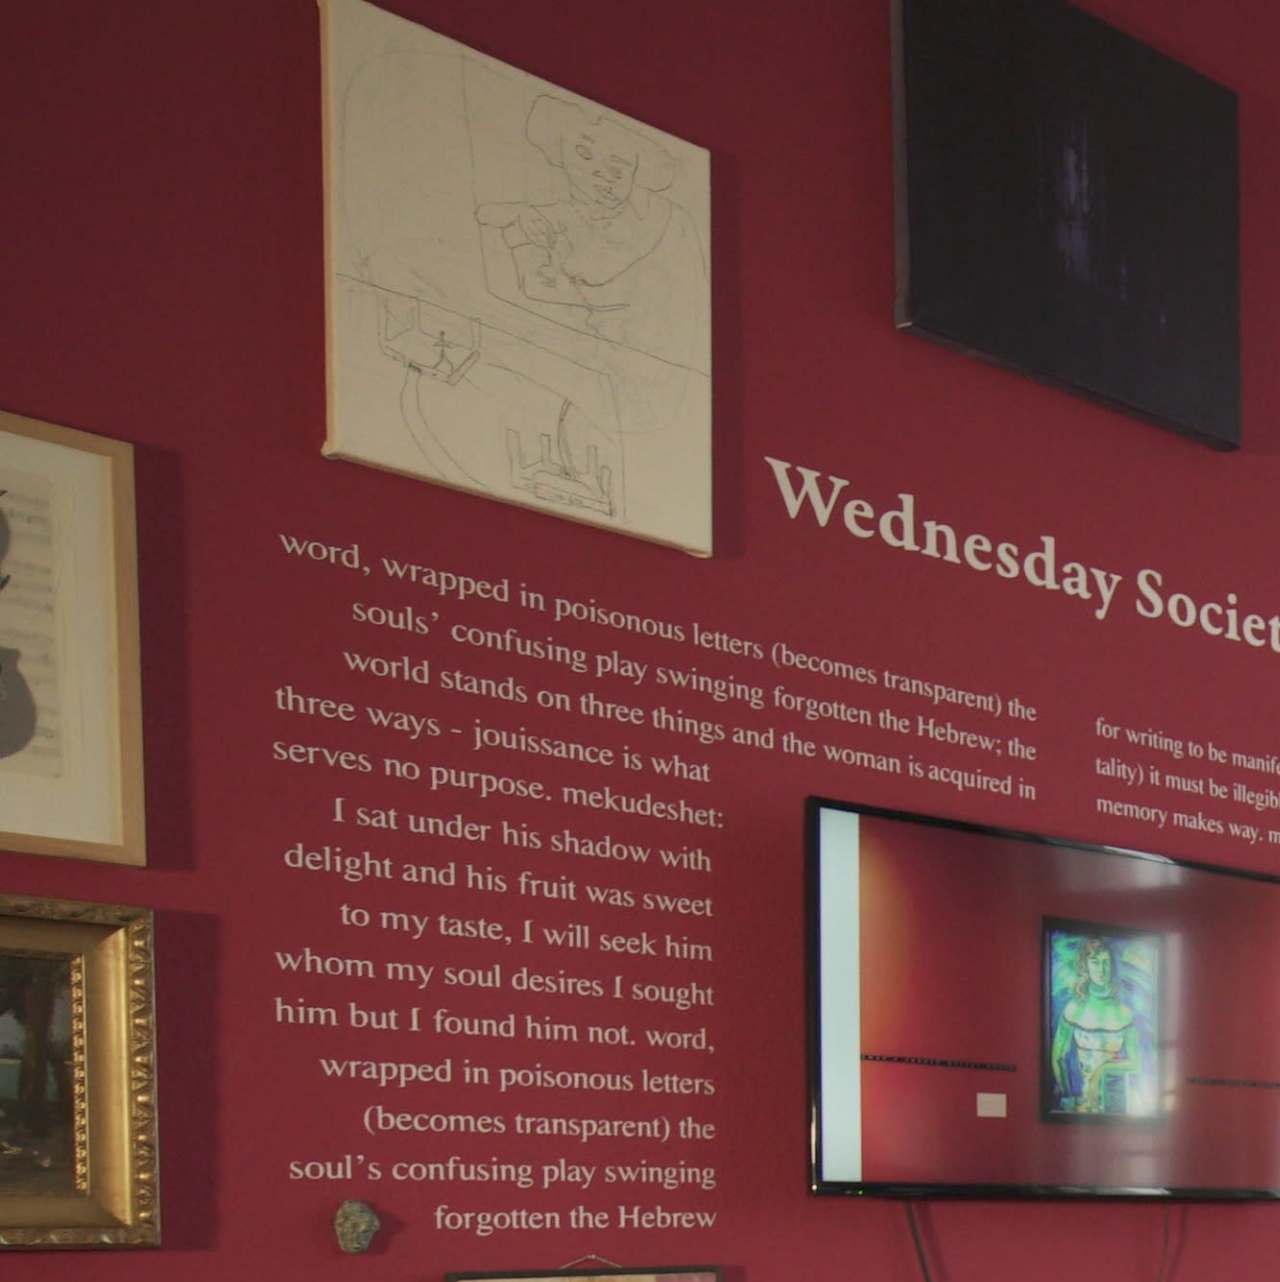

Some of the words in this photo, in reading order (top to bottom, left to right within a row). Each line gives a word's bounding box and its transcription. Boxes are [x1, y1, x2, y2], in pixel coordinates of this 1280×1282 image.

[763, 456, 1123, 621] Wednesday
[278, 534, 371, 576] word,
[380, 557, 509, 603] wrapped
[519, 582, 547, 612] in
[553, 598, 686, 642] poisonous
[692, 622, 764, 660] letters
[770, 642, 878, 685] (becomes
[882, 670, 1002, 718] transparent)
[1007, 697, 1037, 722] the
[342, 651, 429, 685] world
[440, 670, 528, 703] stands
[536, 690, 571, 712] on
[579, 692, 645, 725] three
[651, 706, 726, 744] things
[732, 727, 774, 750] and
[781, 731, 817, 757] the
[822, 744, 902, 774] woman
[907, 754, 925, 778] is
[927, 764, 1012, 796] acquired
[1018, 777, 1036, 800] in
[450, 624, 588, 673] confusing
[594, 650, 648, 686] play
[656, 667, 765, 710] swinging
[772, 685, 872, 726] forgotten
[878, 708, 911, 734] the
[916, 715, 1002, 757] Hebrew;
[1007, 737, 1037, 761] the
[274, 685, 357, 721] three
[365, 706, 442, 740] ways
[472, 718, 615, 766] jouissance
[621, 745, 643, 771] is
[650, 754, 712, 783] what
[1095, 716, 1122, 740] for
[1124, 728, 1184, 759] writing
[1187, 740, 1204, 759] to
[1207, 741, 1228, 764] be
[272, 741, 373, 772] serves
[383, 758, 421, 780] no
[429, 766, 552, 801] purpose.
[561, 786, 724, 829] mekudeshet:
[1095, 757, 1144, 786] tality)
[1149, 765, 1162, 786] it
[1165, 774, 1205, 795] must
[1208, 777, 1229, 799] be
[332, 797, 347, 823] I
[356, 807, 399, 830] sat
[407, 814, 492, 842] under
[501, 820, 542, 849] his
[550, 829, 651, 863] shadow
[658, 845, 712, 873] with
[1096, 798, 1168, 829] memory
[1172, 811, 1225, 835] makes
[283, 842, 394, 882] delight
[401, 862, 456, 886] and
[465, 864, 508, 893] his
[517, 871, 577, 901] fruit
[585, 885, 635, 908] was
[642, 893, 714, 917] sweet
[339, 903, 370, 927] to
[379, 912, 430, 940] my
[437, 914, 512, 946] taste,
[521, 919, 534, 944] I
[542, 923, 590, 950] will
[599, 931, 658, 956] seek
[664, 933, 713, 962] him
[274, 947, 376, 978] whom
[384, 962, 435, 990] my
[444, 964, 501, 988] soul
[511, 966, 604, 997] desires
[612, 975, 624, 999] I
[632, 982, 715, 1011] sought
[272, 996, 340, 1026] him
[347, 1001, 400, 1031] but
[408, 1007, 422, 1032] I
[432, 1008, 515, 1038] found
[524, 1014, 579, 1043] him
[587, 1024, 636, 1046] not.
[645, 1027, 715, 1054] word,
[319, 1058, 452, 1088] wrapped
[462, 1059, 490, 1085] in
[498, 1062, 634, 1093] poisonous
[641, 1068, 716, 1096] letters
